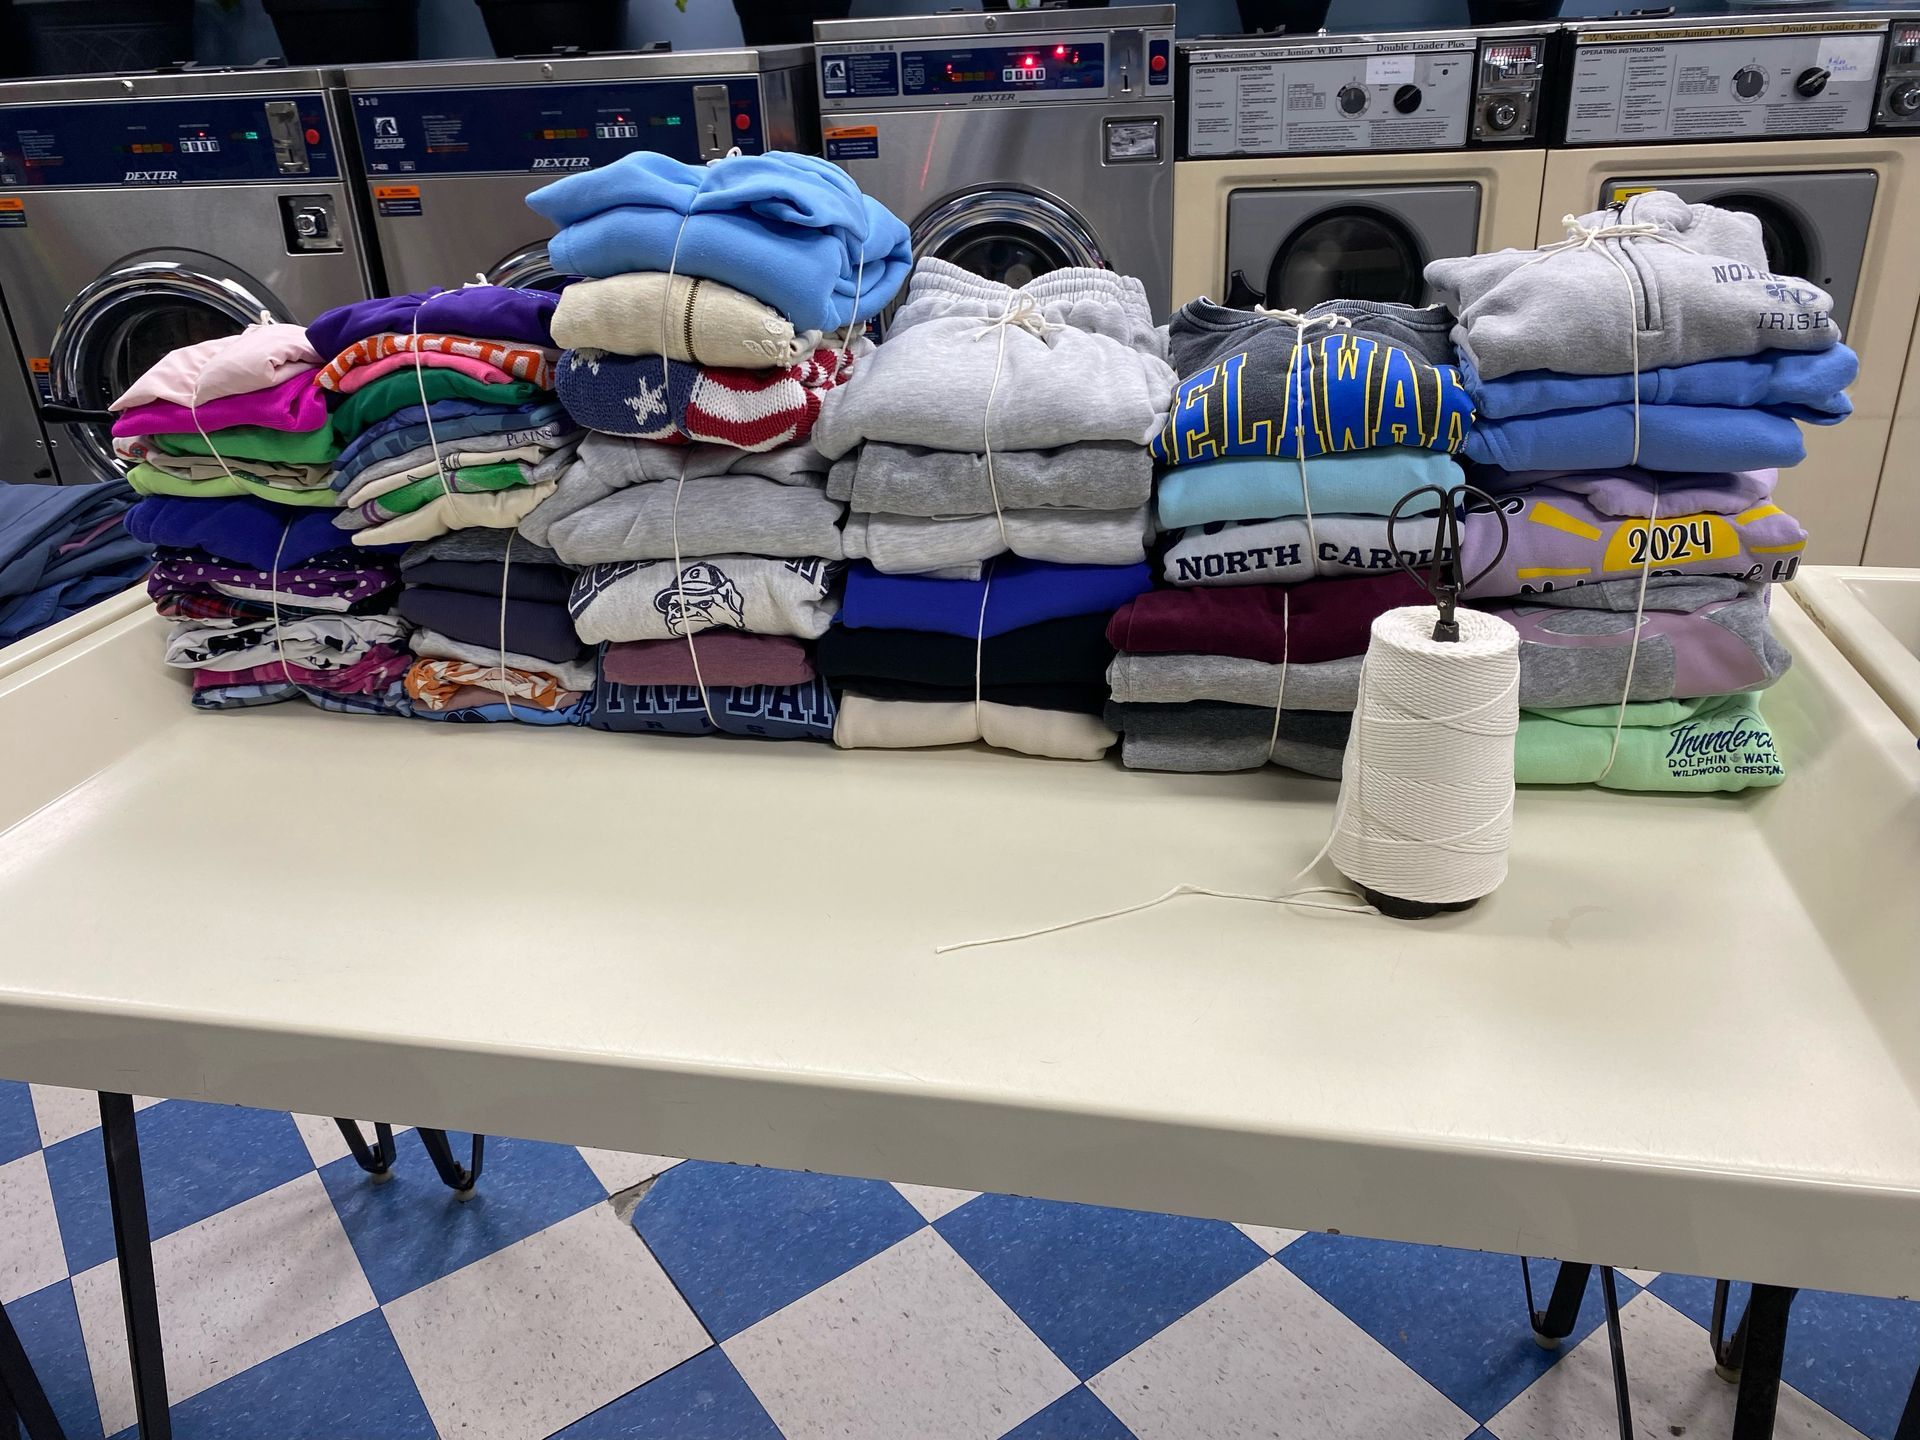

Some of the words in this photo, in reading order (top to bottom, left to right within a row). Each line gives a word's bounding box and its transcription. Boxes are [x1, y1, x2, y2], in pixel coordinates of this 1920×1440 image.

[1781, 25, 1817, 33] Double
[1821, 23, 1855, 31] Loader
[1605, 33, 1650, 41] Wascomat
[1376, 43, 1409, 52] Double
[1413, 41, 1444, 50] Loader
[1448, 41, 1466, 49] Plus
[1581, 48, 1617, 56] OPERATING
[1618, 46, 1665, 54] INSTRUCTIONS
[1215, 51, 1256, 59] Wascomat
[1231, 65, 1272, 73] INSTRUCTIONS
[971, 93, 1016, 102] DEXTER
[532, 157, 590, 168] DEXTER
[124, 170, 178, 181] DEXTER
[1756, 311, 1830, 331] IRISH
[506, 429, 553, 446] PLAINS
[1627, 519, 1713, 567] 2024
[1175, 543, 1302, 581] NORTH
[1668, 754, 1727, 768] DOLPHIN
[1672, 765, 1730, 777] WILDWOOD
